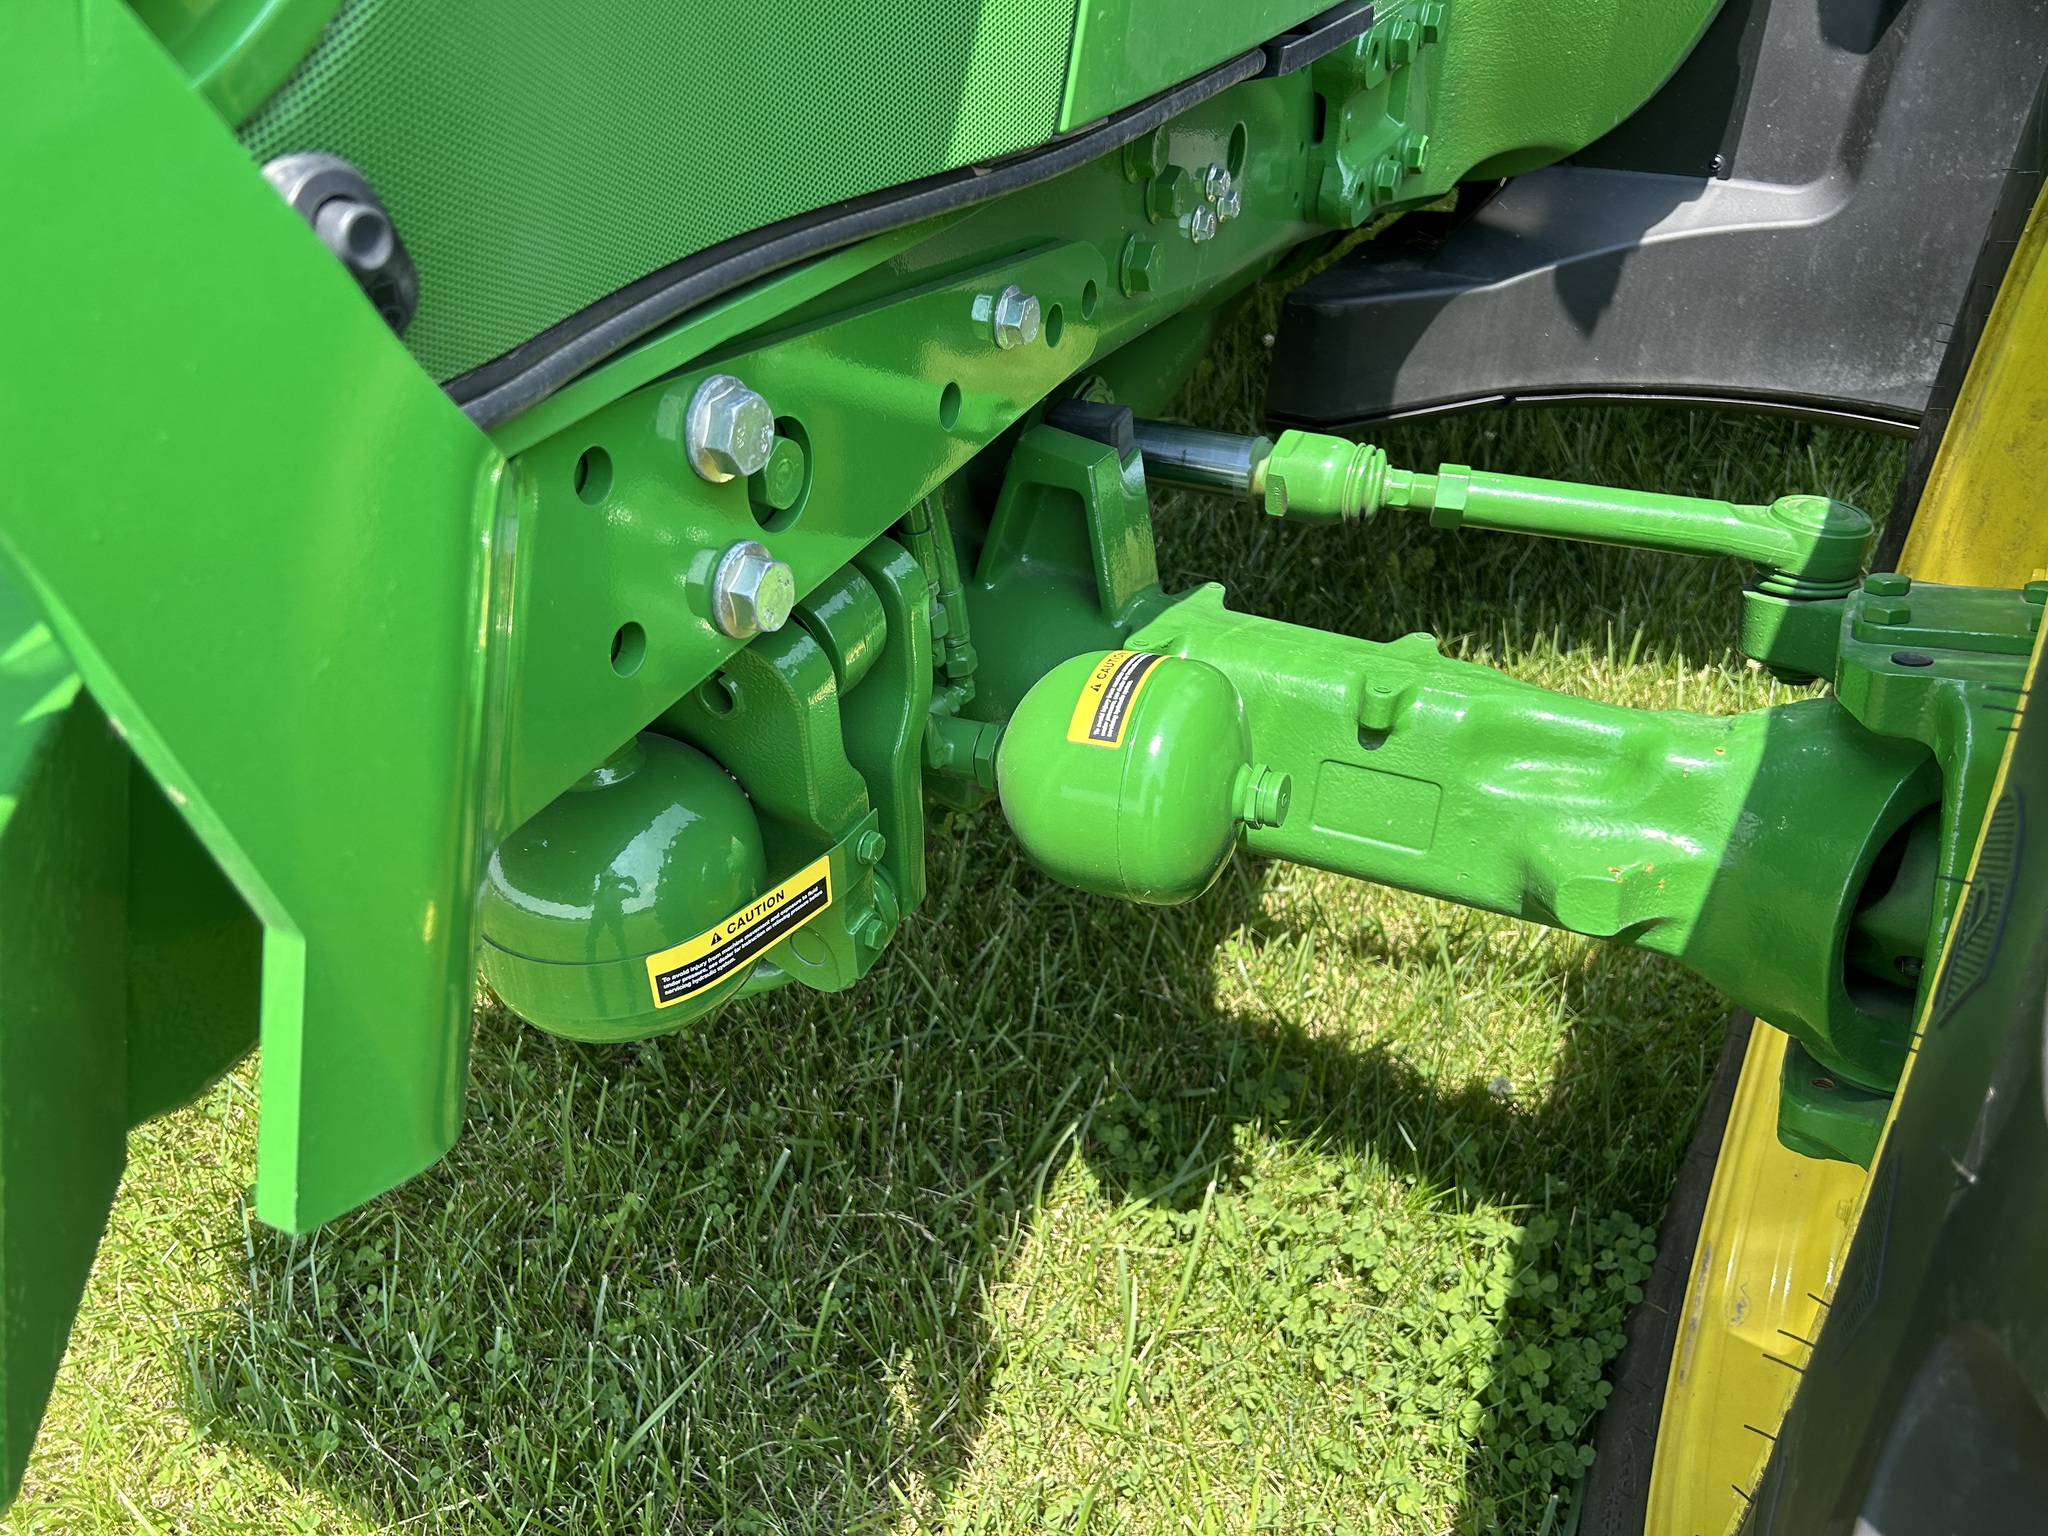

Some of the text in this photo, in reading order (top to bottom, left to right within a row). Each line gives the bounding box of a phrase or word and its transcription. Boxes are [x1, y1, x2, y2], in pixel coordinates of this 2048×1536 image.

[672, 968, 690, 980] avoid
[690, 961, 708, 973] injury
[708, 953, 721, 963] from
[722, 938, 744, 955] machine
[744, 920, 770, 940] movement
[771, 913, 780, 922] and
[780, 898, 802, 915] exposure
[727, 890, 785, 934] CAUTION
[663, 978, 681, 989] under
[682, 968, 708, 983] pressure,
[719, 951, 734, 965] dealer
[790, 899, 809, 916] pressure
[664, 982, 692, 996] servicing
[692, 968, 717, 984] hydraulic
